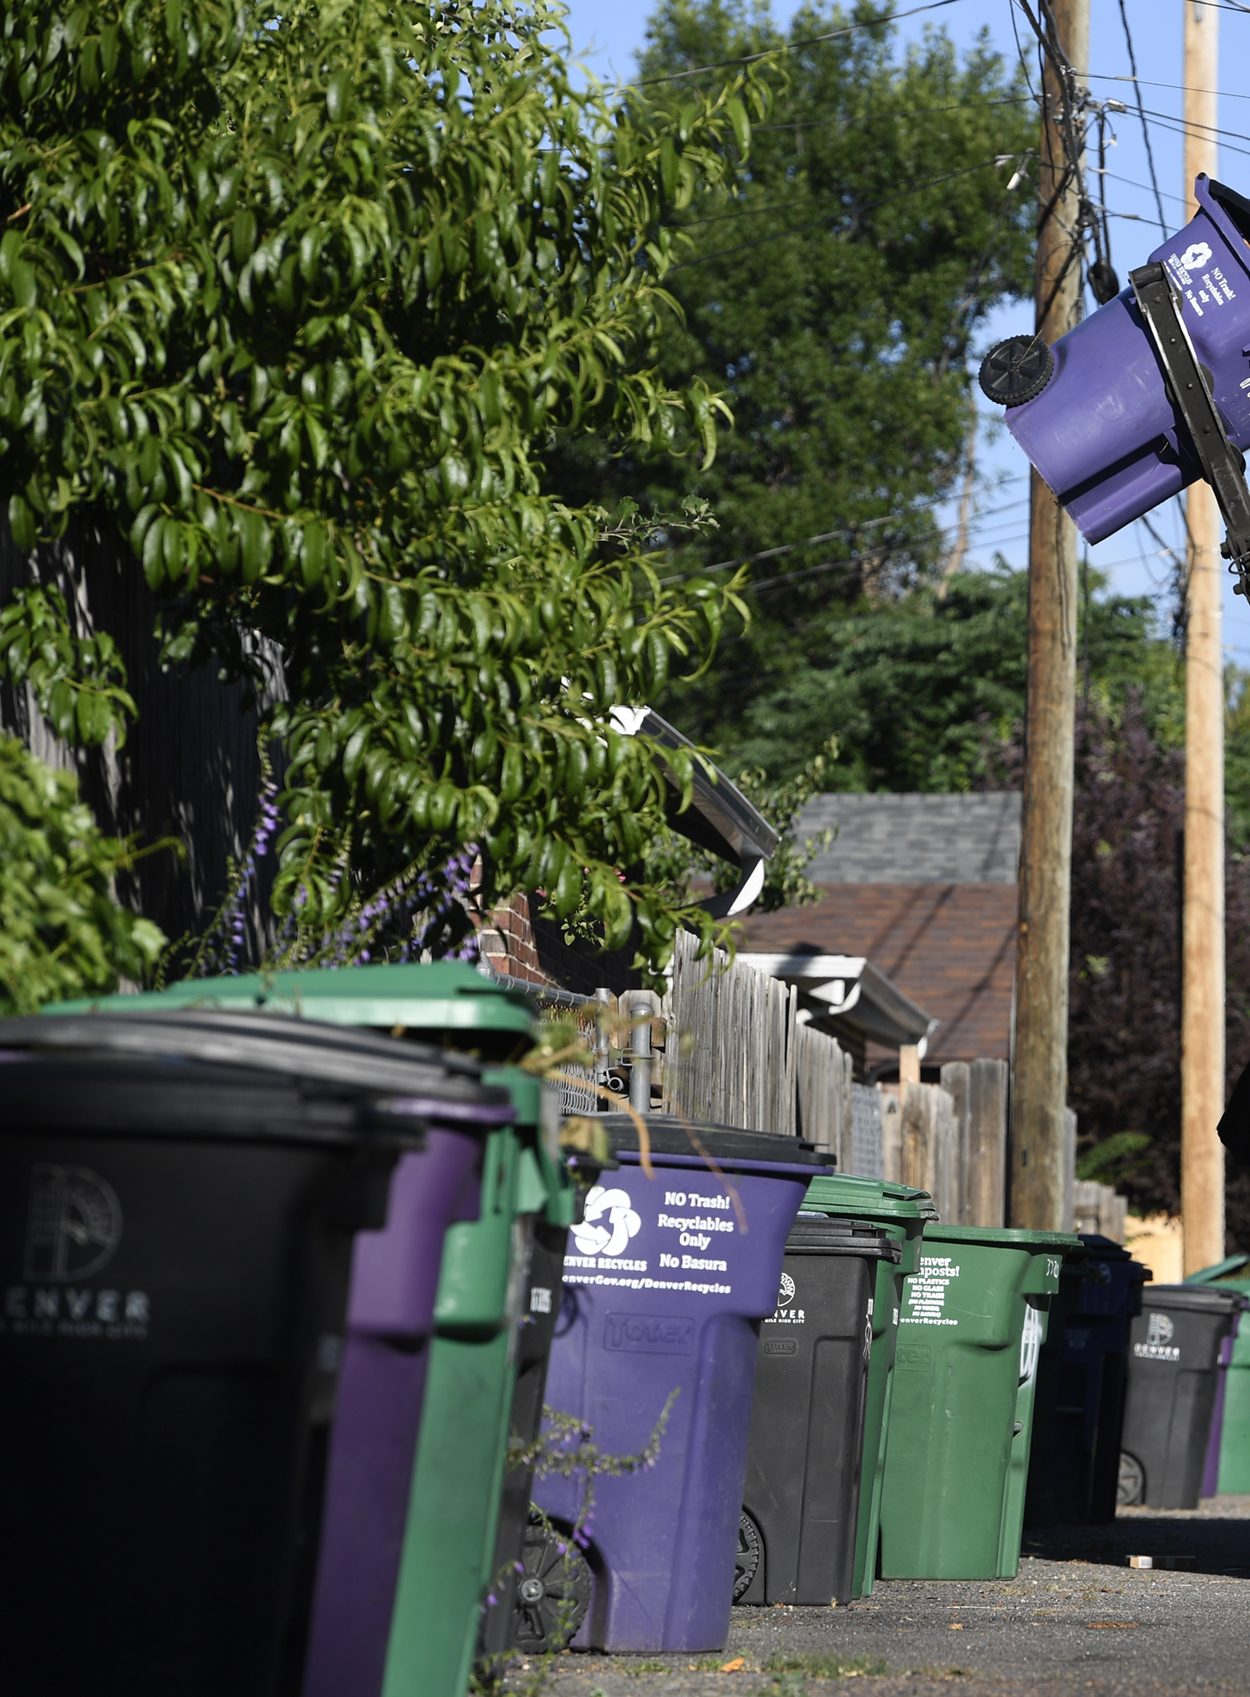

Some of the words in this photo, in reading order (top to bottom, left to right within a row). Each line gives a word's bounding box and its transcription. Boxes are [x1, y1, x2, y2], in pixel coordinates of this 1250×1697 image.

[1202, 273, 1224, 306] Recyclables
[1211, 267, 1223, 280] NO
[1219, 278, 1236, 300] Trash!
[665, 1192, 686, 1206] NO
[689, 1194, 731, 1210] Trash!
[658, 1214, 734, 1232] Recyclables
[679, 1233, 711, 1251] Only
[598, 1257, 647, 1271] RECYCLES
[659, 1254, 680, 1268] No
[681, 1255, 727, 1271] Basura
